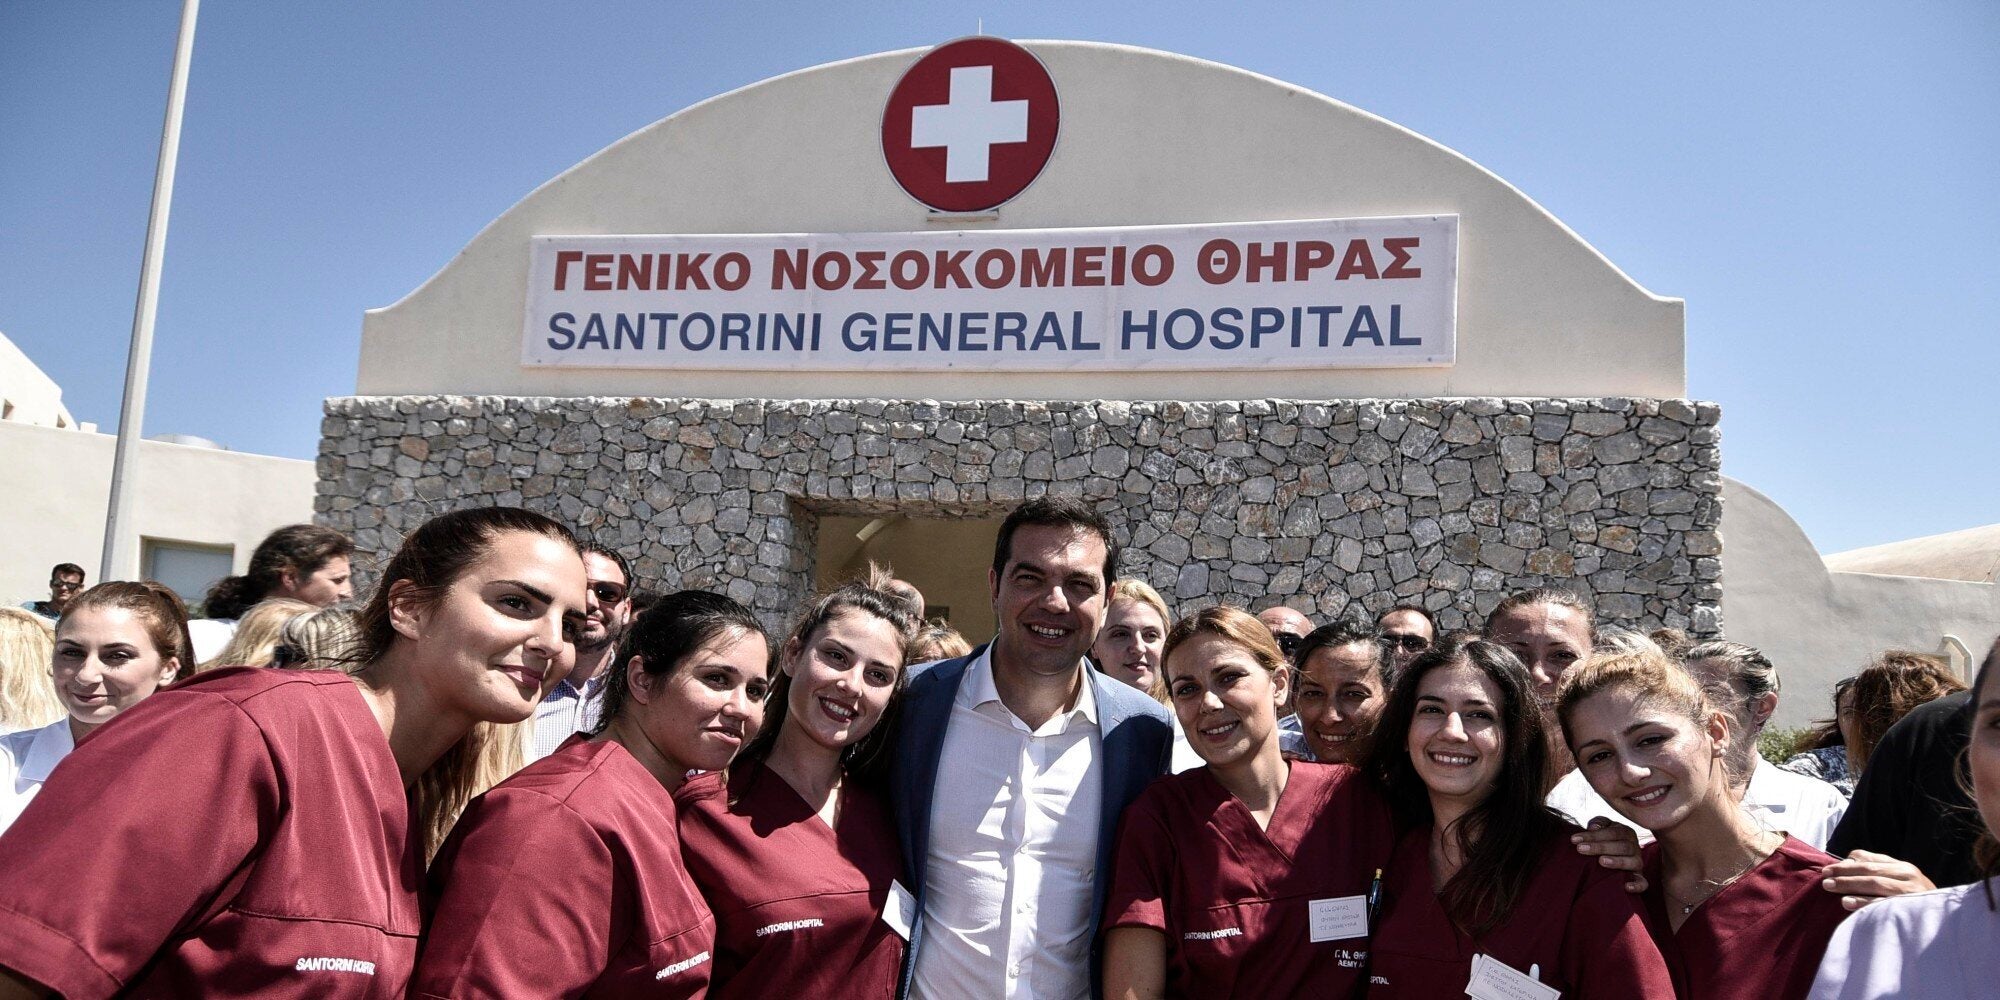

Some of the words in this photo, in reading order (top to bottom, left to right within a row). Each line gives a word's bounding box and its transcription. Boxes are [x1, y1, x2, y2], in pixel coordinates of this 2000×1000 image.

[554, 250, 751, 291] ΓΕΝΙΚΟ
[771, 244, 1174, 290] ΝΟΣΟΚΟΜΕΙΟ
[1197, 237, 1421, 285] ΘΗΡΑΣ
[547, 312, 822, 351] SANTORINI
[841, 311, 1101, 352] GENERAL
[1121, 304, 1422, 351] HOSPITAL
[756, 921, 793, 937] SANTORINI
[793, 919, 824, 929] HOSPITAL
[1211, 928, 1242, 939] HOSPITAL
